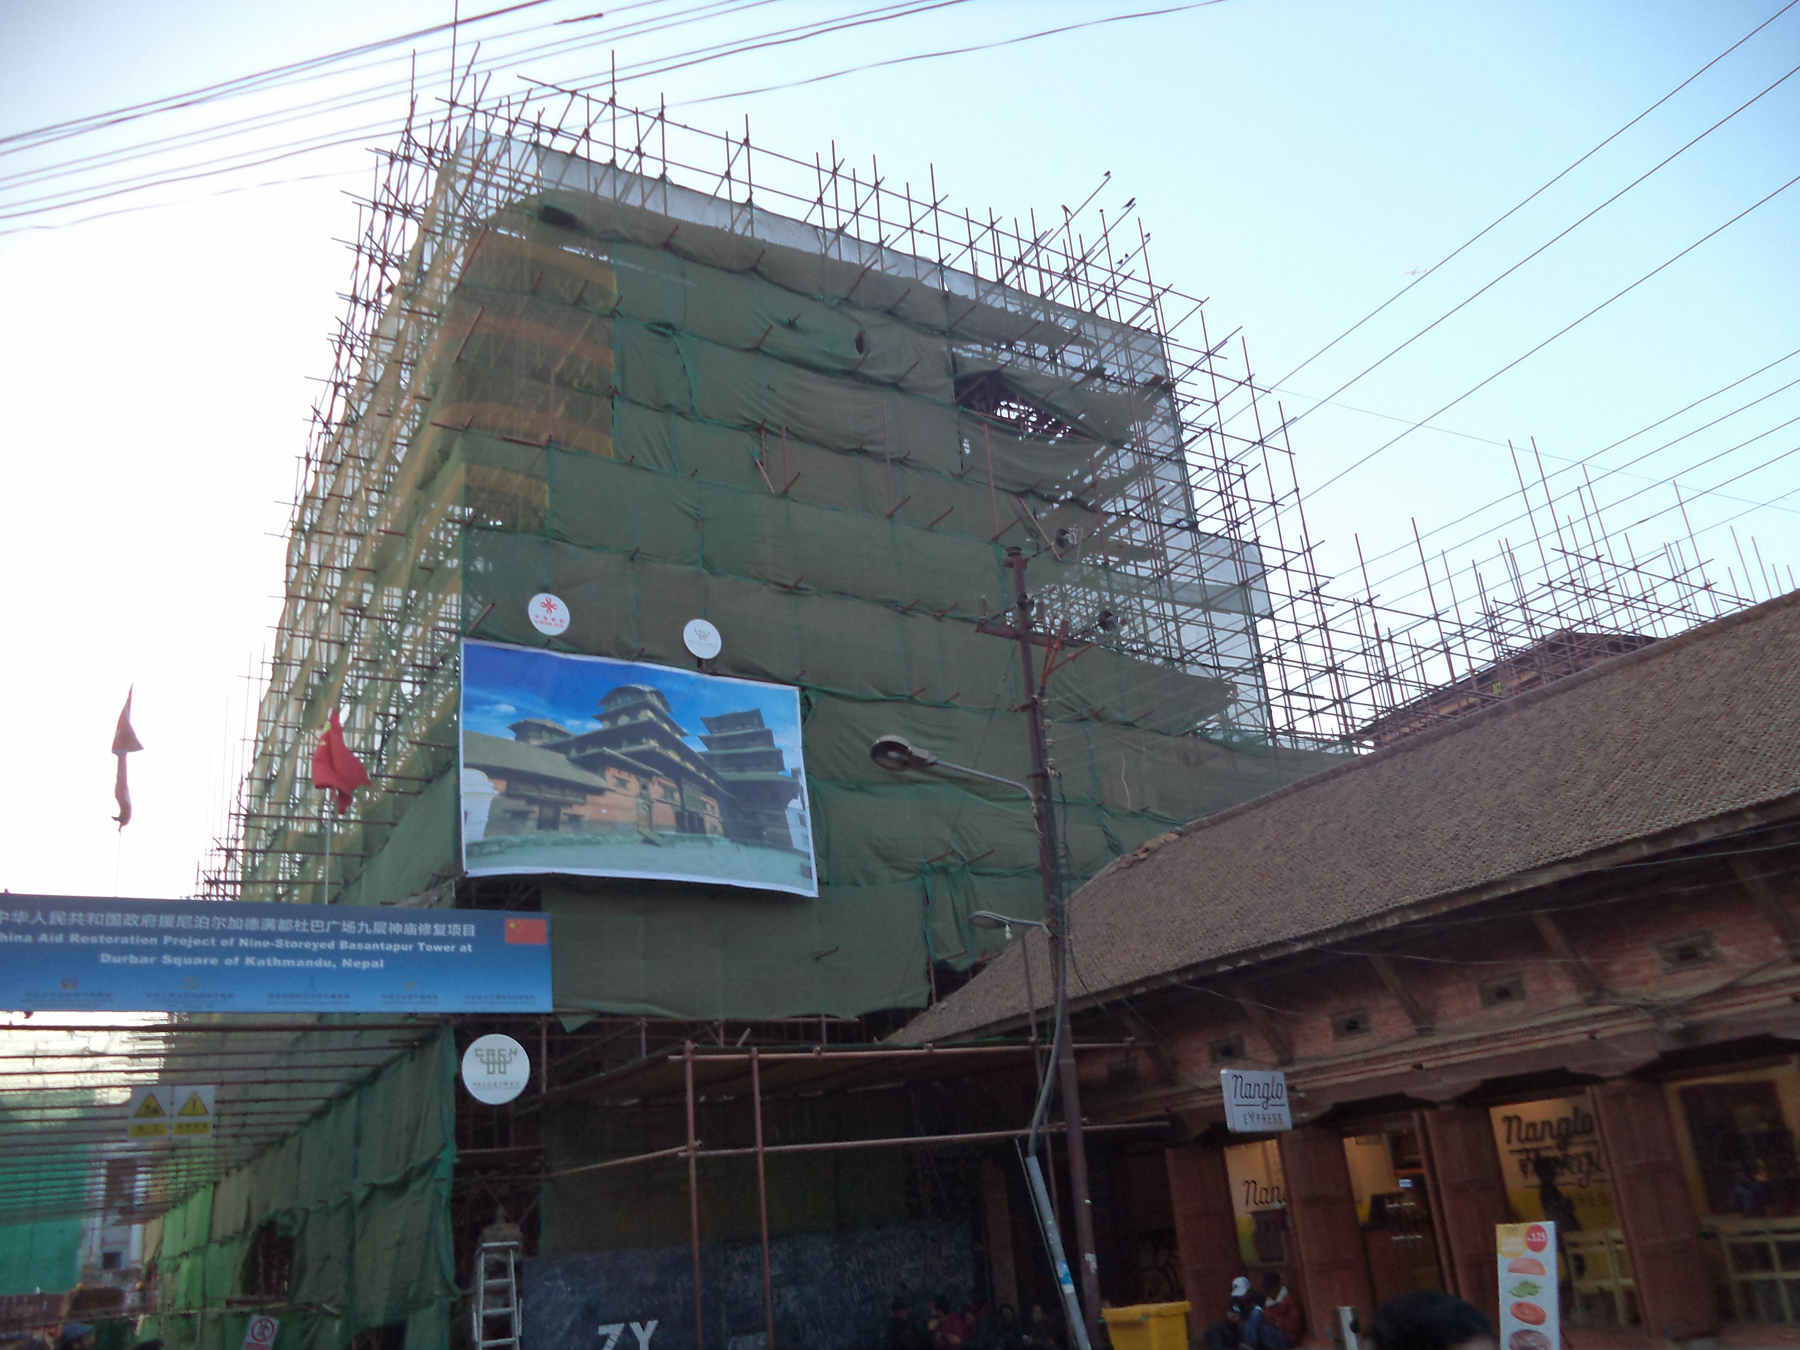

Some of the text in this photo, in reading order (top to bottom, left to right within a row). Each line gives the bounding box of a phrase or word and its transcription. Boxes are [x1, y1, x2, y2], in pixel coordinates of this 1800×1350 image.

[38, 932, 64, 943] Aid
[69, 933, 158, 945] Restoration
[163, 935, 216, 948] Project
[220, 937, 235, 947] of
[239, 937, 335, 951] Nine-Storeyed
[339, 940, 414, 953] Basantapur
[417, 942, 456, 952] Tower
[459, 943, 473, 952] at
[100, 952, 385, 970] Durbar Square of Kathmandu, Nepal
[1232, 1074, 1284, 1110] Nanglo
[1243, 1111, 1283, 1125] EXPRESS
[1502, 1107, 1595, 1151] Nanglo
